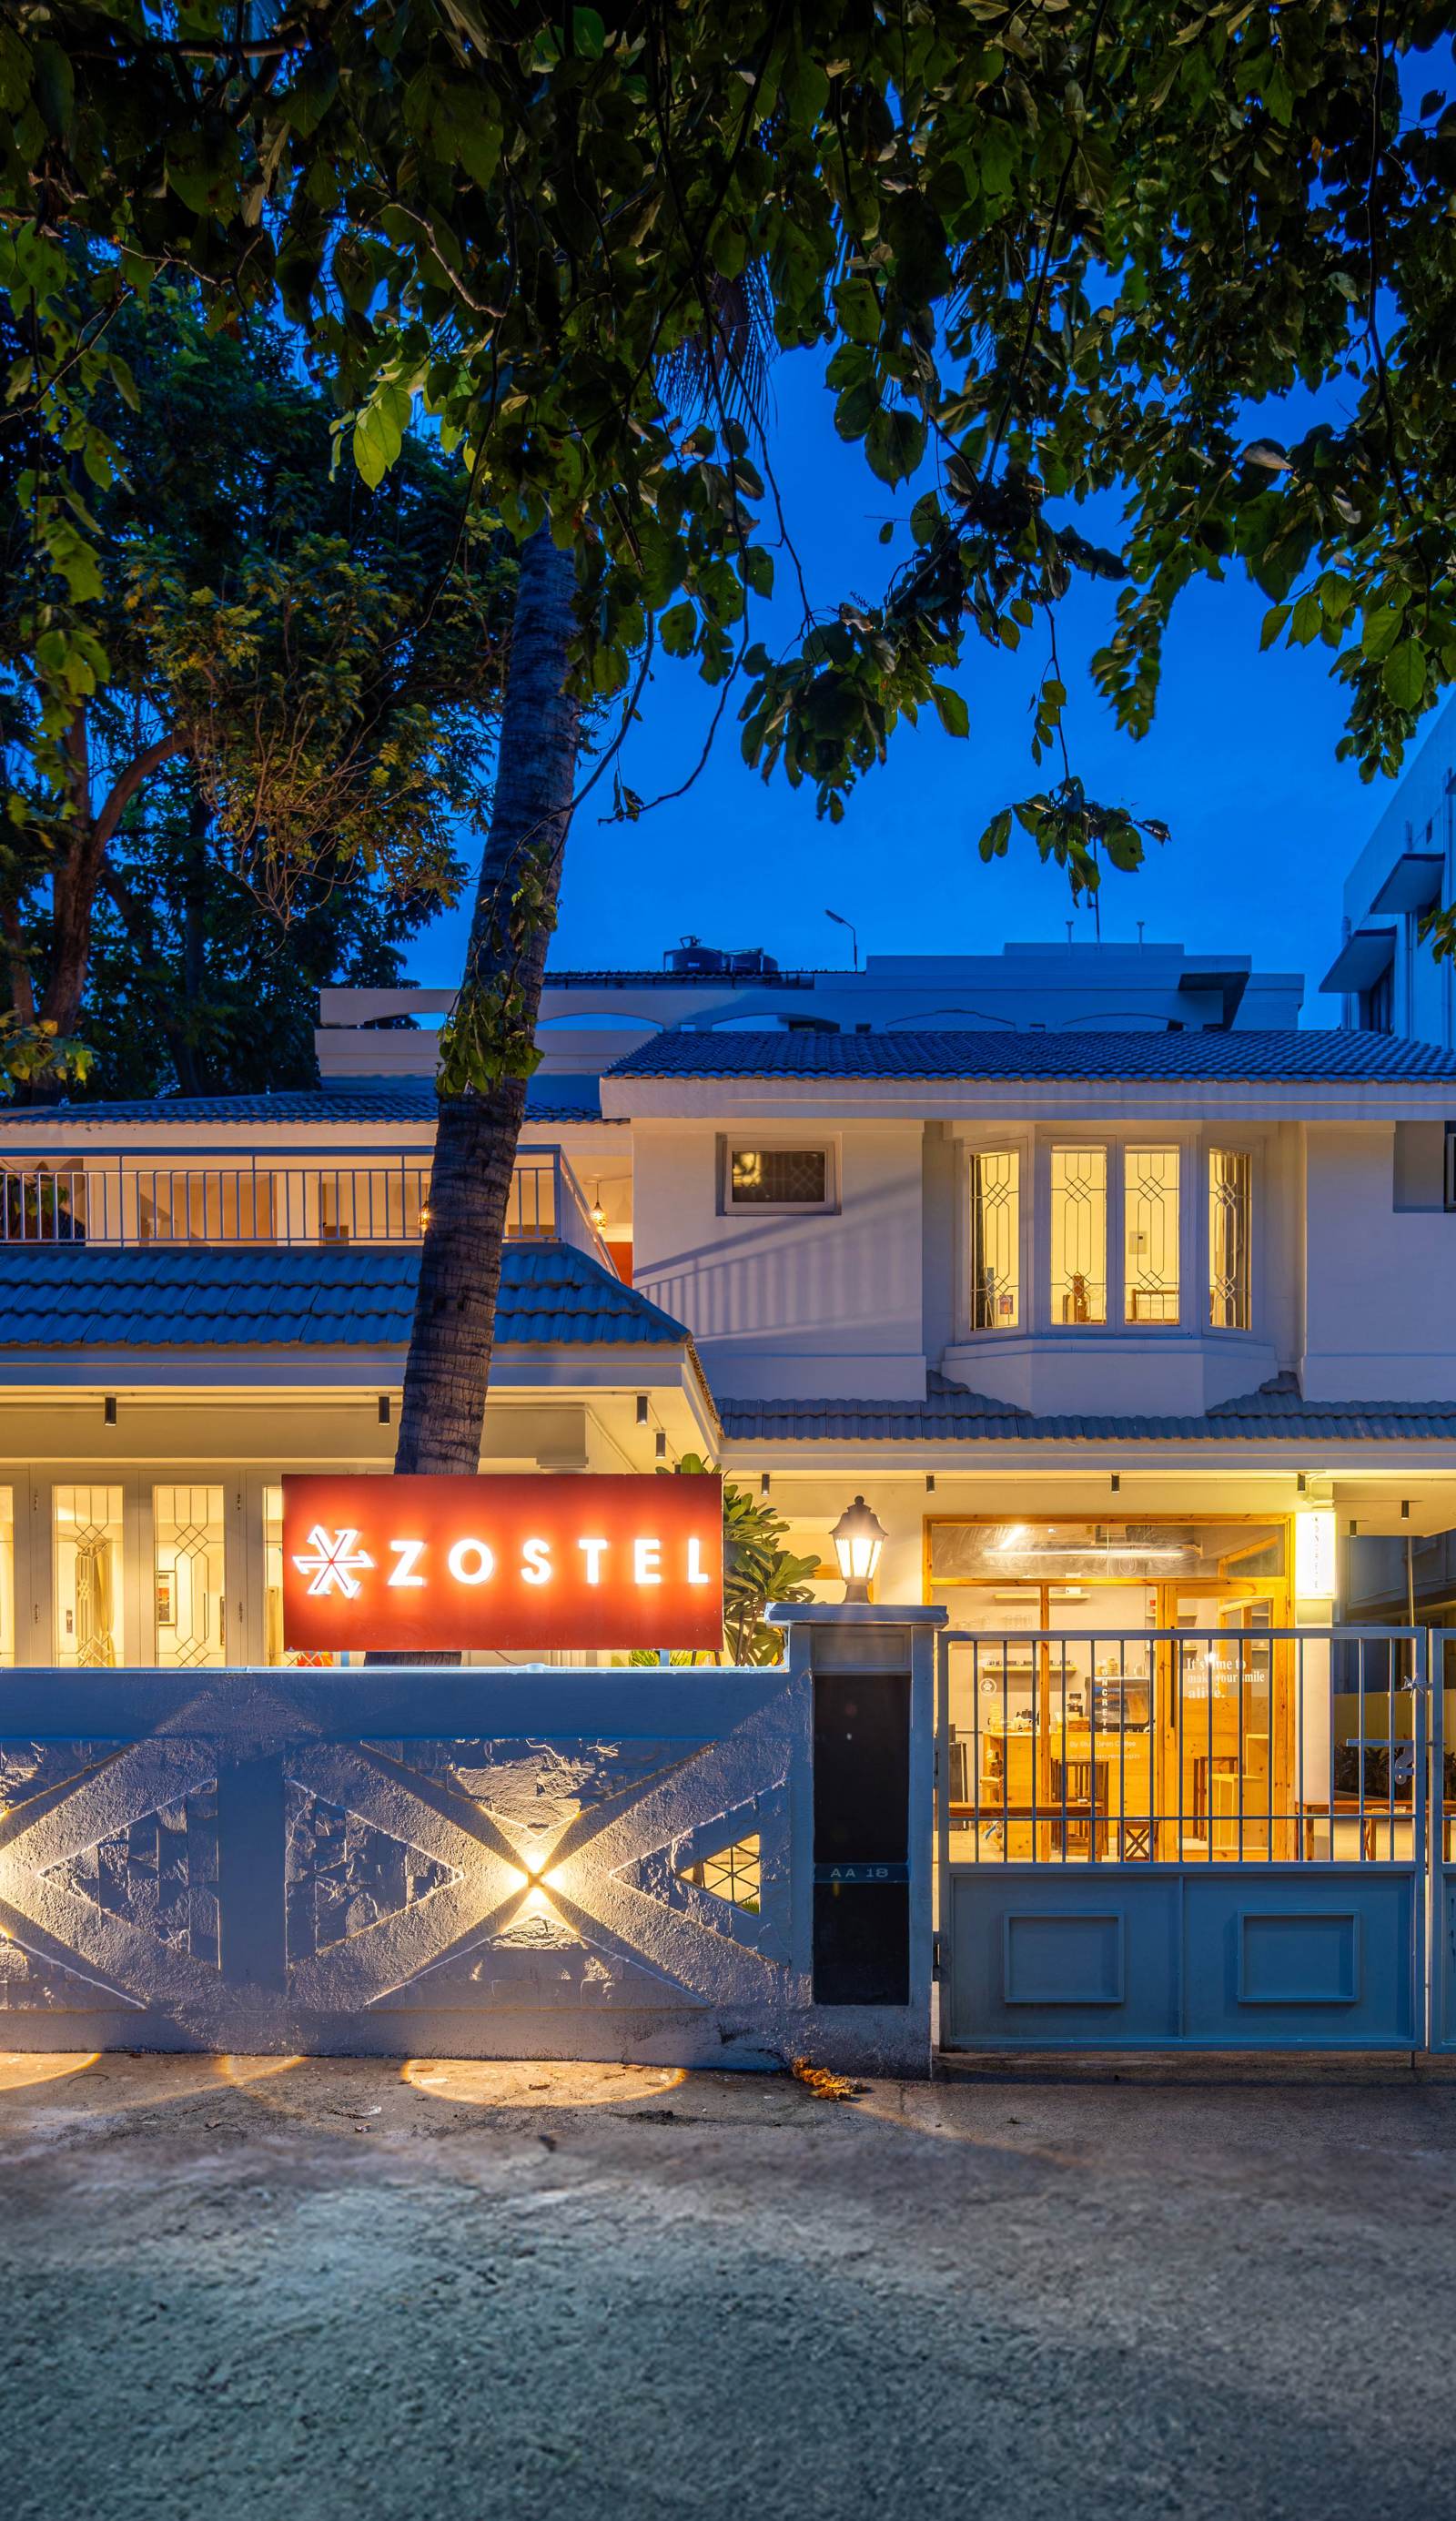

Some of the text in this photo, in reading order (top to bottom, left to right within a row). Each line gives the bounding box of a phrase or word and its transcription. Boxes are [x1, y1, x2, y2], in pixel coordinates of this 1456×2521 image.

[388, 1538, 710, 1586] ZOSTEL
[1186, 1657, 1205, 1671] It's
[1188, 1671, 1212, 1683] mak
[1240, 1670, 1265, 1683] mile
[866, 1868, 889, 1878] 18
